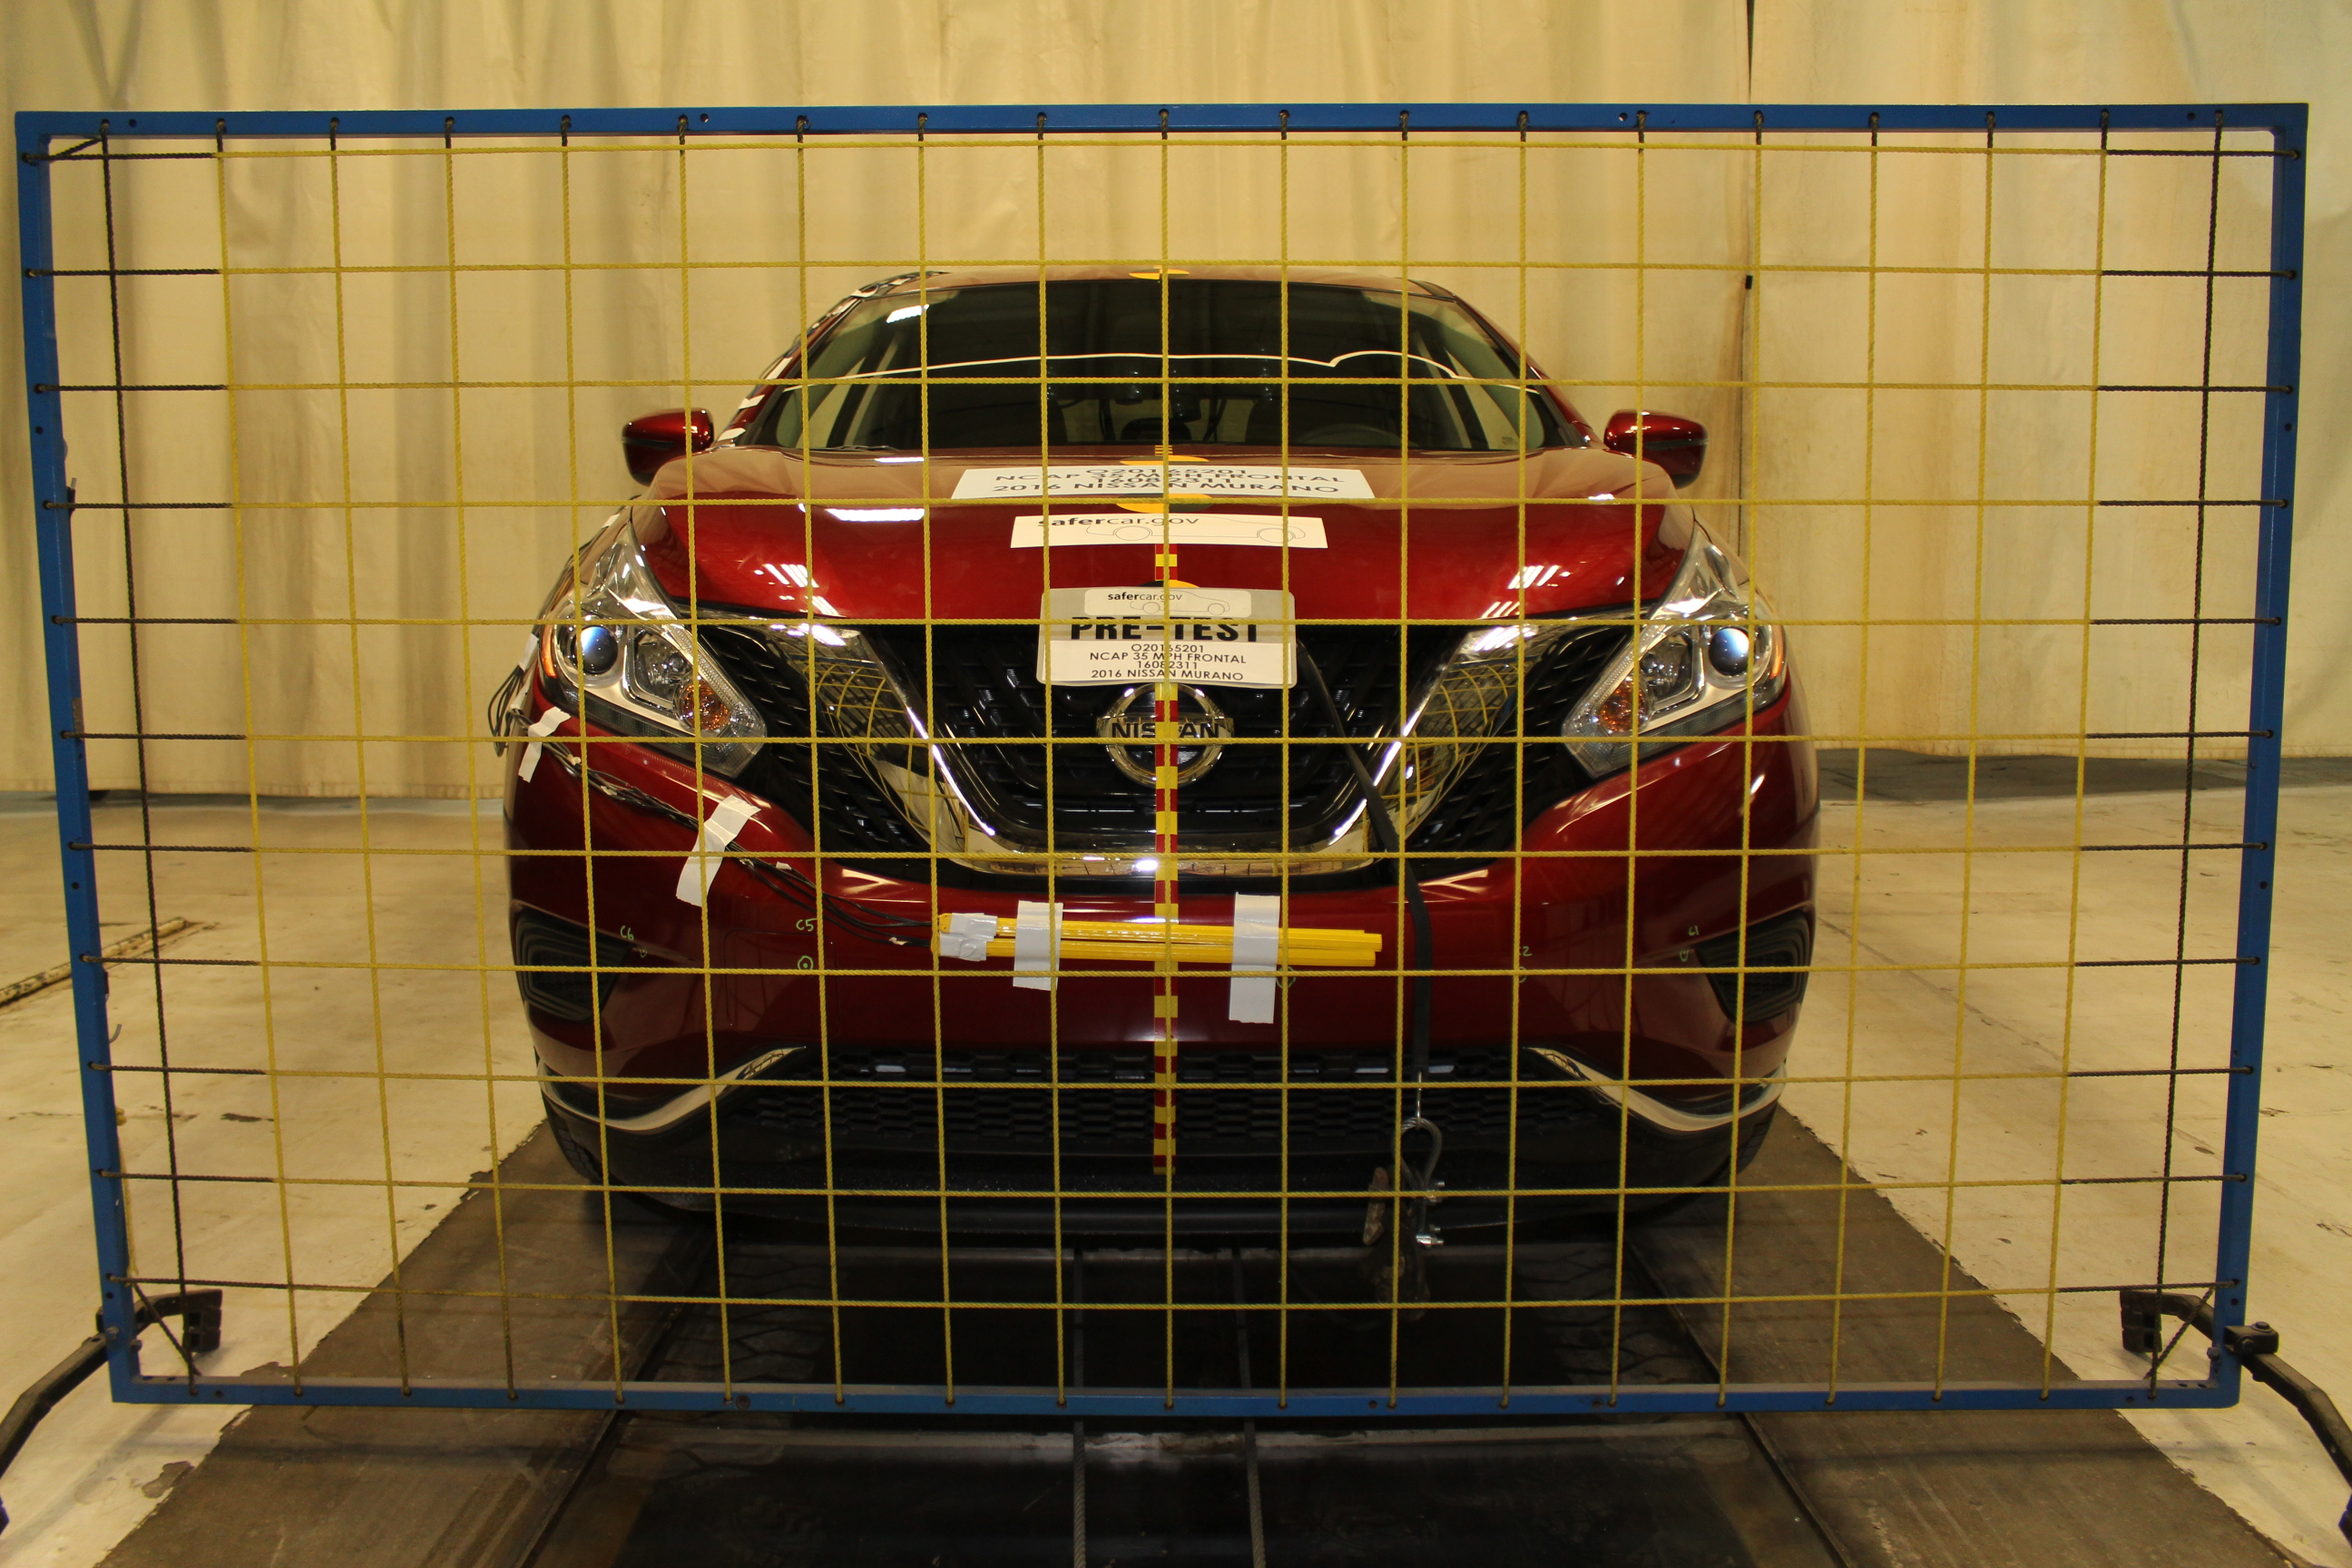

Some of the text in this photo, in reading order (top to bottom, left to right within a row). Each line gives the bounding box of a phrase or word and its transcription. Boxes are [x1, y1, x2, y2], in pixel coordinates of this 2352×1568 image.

[1215, 474, 1346, 483] FRONTAL
[992, 484, 1062, 492] 2016
[1199, 483, 1339, 493] MURANO
[1071, 616, 1262, 642] PRE-TEST
[1090, 652, 1129, 661] NCAP
[1132, 652, 1149, 661] 35
[1187, 653, 1247, 663] FRONTAL
[1137, 660, 1198, 670] 16082311
[1091, 669, 1244, 681] 2016 NISSAN MURANO
[1112, 722, 1220, 739] NISAN
